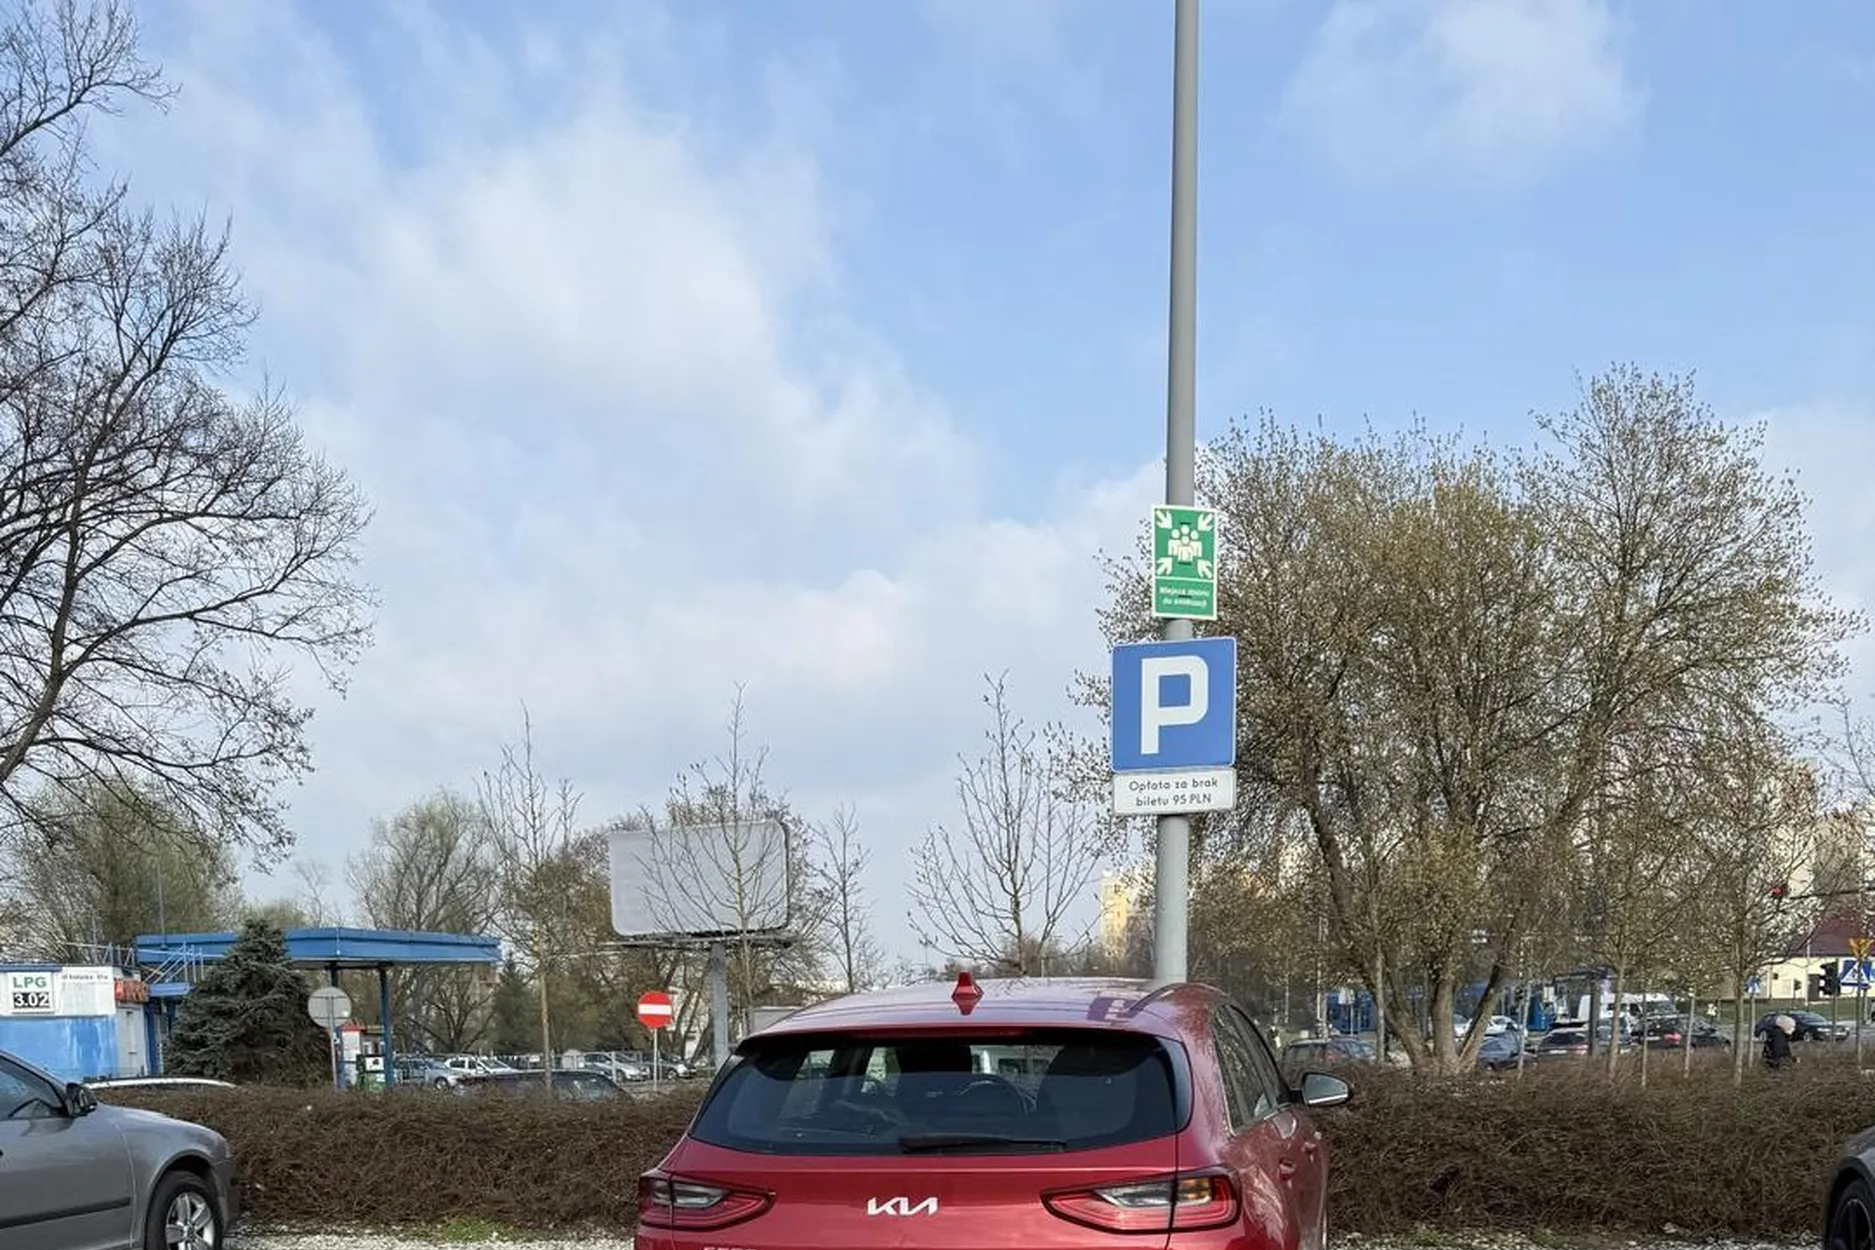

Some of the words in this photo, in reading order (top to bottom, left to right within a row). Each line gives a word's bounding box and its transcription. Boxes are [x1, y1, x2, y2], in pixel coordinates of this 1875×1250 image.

[1141, 655, 1208, 754] P
[1129, 780, 1170, 793] Opłata
[1175, 781, 1188, 789] za
[1192, 777, 1218, 788] brak
[1136, 795, 1169, 806] biletu
[1173, 794, 1187, 805] 95
[1190, 793, 1211, 804] PLN
[13, 976, 46, 988] LPG
[14, 992, 49, 1008] 3.02
[867, 1197, 938, 1216] KIA
